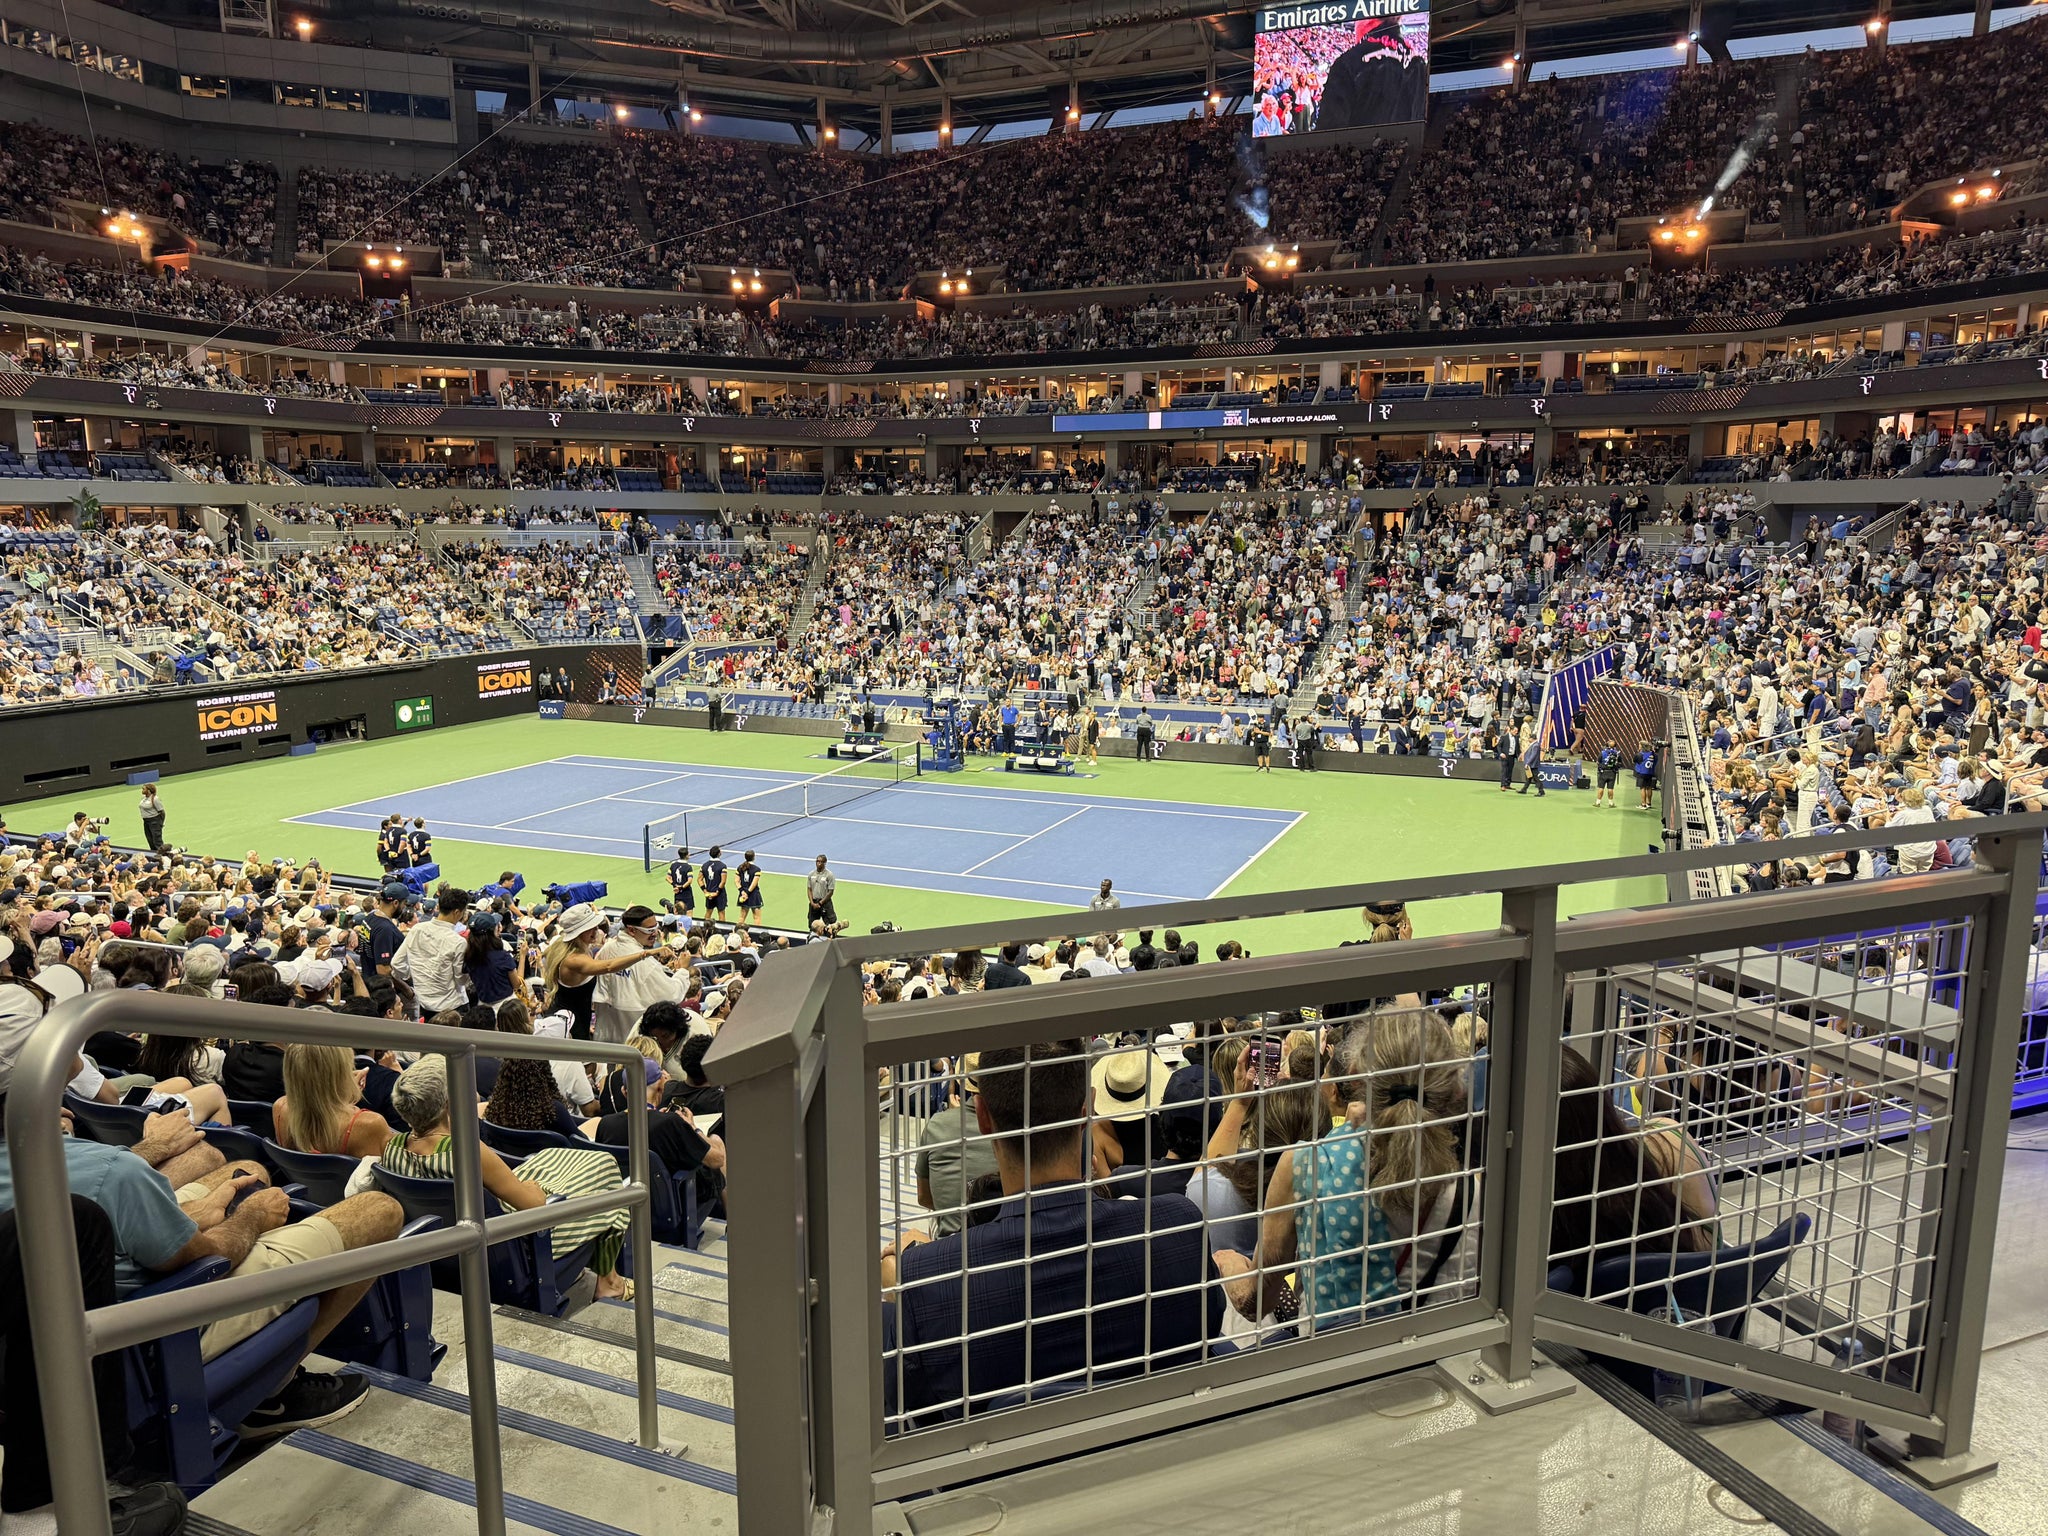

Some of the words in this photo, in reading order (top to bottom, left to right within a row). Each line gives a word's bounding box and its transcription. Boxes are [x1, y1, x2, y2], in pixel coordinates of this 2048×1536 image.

[1264, 4, 1347, 30] Emirates
[1860, 376, 1875, 395] RF
[122, 385, 137, 403] RF
[264, 397, 277, 414] RF
[1379, 404, 1393, 420] RF
[1530, 399, 1545, 415] RF
[548, 412, 562, 427] RF
[682, 417, 695, 431] RF
[969, 419, 981, 433] RF
[1223, 416, 1243, 426] IBM
[501, 660, 530, 668] FEDERER
[478, 670, 531, 692] ICON
[196, 696, 232, 707] ROGER
[232, 691, 276, 702] FEDERER
[479, 689, 511, 698] RETURNS
[198, 703, 278, 732] ICON
[633, 708, 646, 723] RF
[734, 715, 748, 730] RF
[200, 727, 248, 740] RETURNS
[249, 725, 263, 733] TO
[264, 723, 278, 731] NY
[1150, 740, 1167, 758] RF
[1437, 758, 1458, 777] RF
